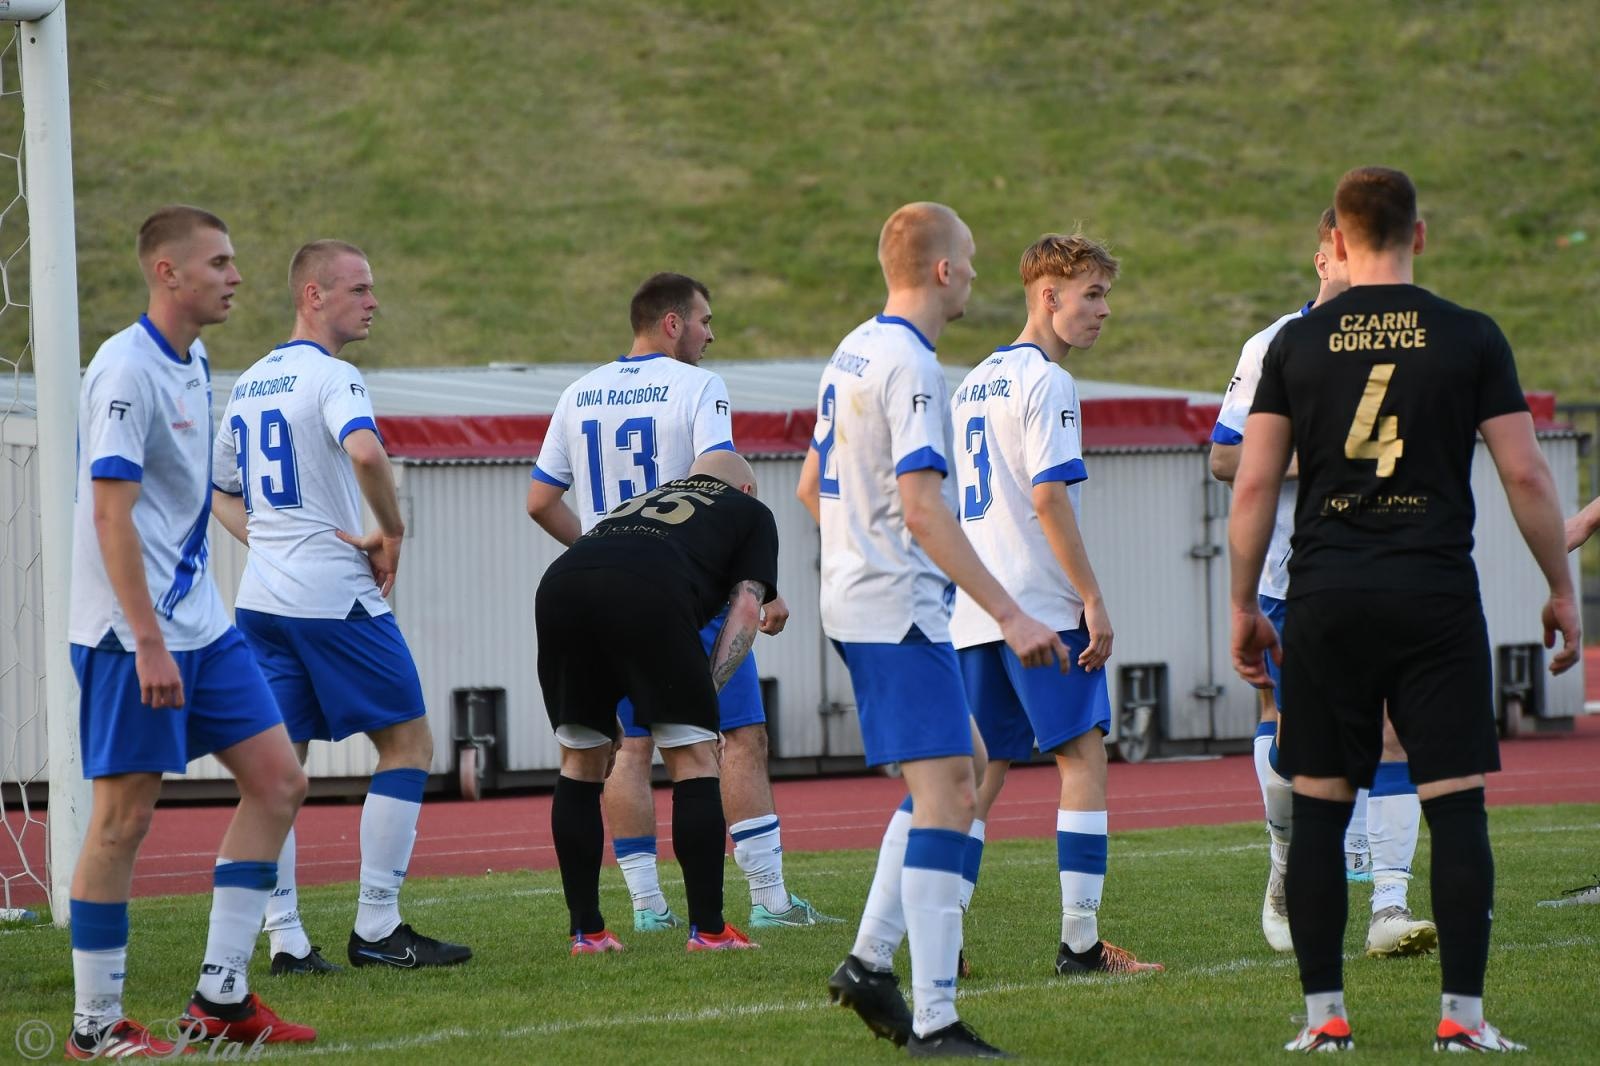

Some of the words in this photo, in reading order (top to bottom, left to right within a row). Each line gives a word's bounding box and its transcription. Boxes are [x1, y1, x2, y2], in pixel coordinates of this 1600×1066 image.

[1340, 311, 1418, 332] CZARNI
[1329, 328, 1427, 353] GORZYCE
[576, 388, 603, 408] UNIA
[606, 383, 670, 406] RACIBÓRZ
[1344, 363, 1404, 478] 4
[581, 416, 660, 517] 13
[964, 415, 994, 522] 3
[1364, 495, 1428, 507] LINIC
